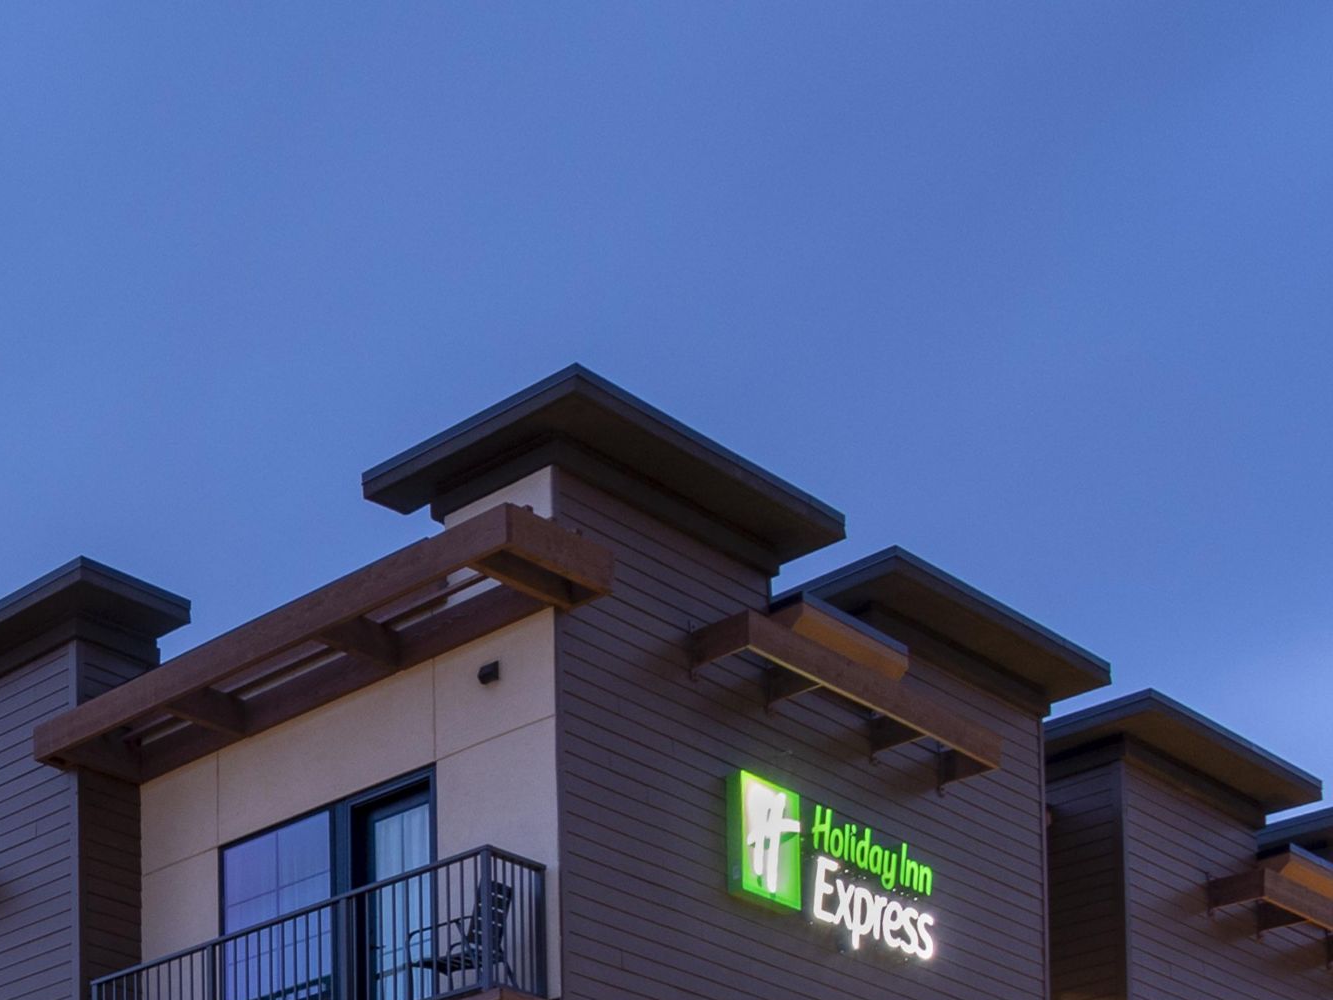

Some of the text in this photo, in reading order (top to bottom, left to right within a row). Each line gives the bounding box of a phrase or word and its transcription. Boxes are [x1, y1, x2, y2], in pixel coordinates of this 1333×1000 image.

[812, 804, 933, 896] Holiday Inn
[813, 855, 934, 961] Express
